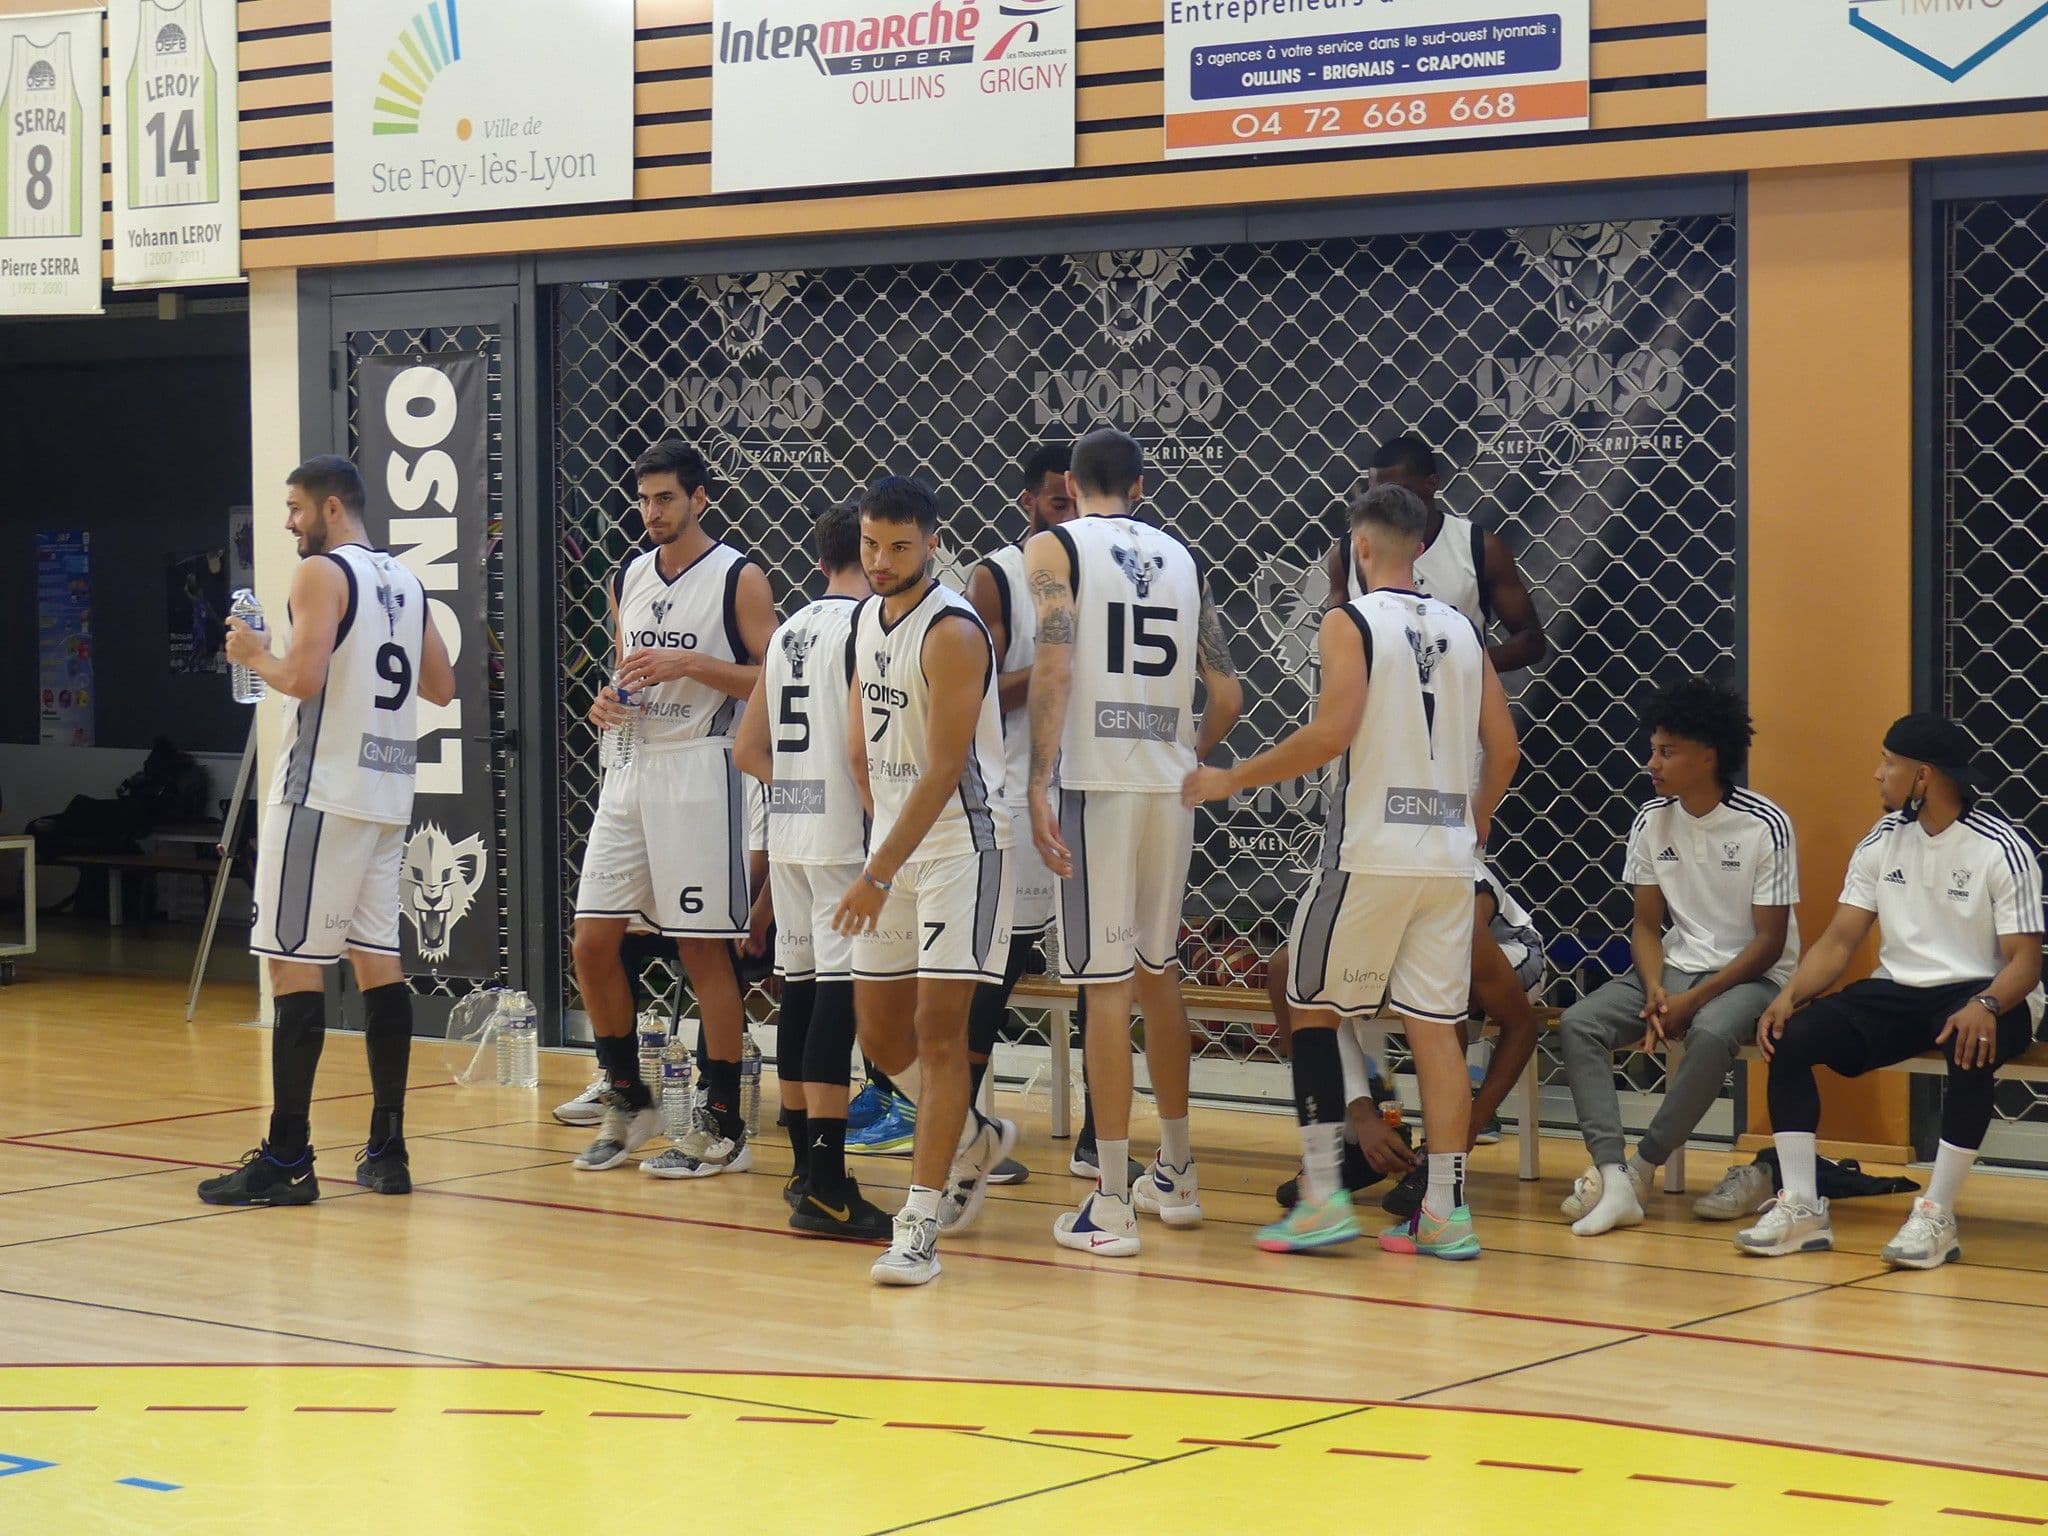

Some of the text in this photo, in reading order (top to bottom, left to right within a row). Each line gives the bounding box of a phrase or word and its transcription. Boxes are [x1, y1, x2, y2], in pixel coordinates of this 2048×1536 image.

[851, 50, 951, 71] SUPER
[1195, 53, 1204, 66] 3
[1208, 49, 1262, 67] agences
[1266, 46, 1276, 60] à
[1280, 44, 1313, 58] votre
[1317, 39, 1363, 55] service
[1368, 37, 1400, 51] dans
[1404, 34, 1418, 48] le
[1422, 27, 1488, 46] sud-ouest
[1493, 22, 1547, 42] lyonnais
[146, 74, 200, 102] LEROY
[853, 63, 1067, 105] OULLINS GRIGNY
[1241, 68, 1302, 87] OULLINS
[1322, 60, 1395, 81] BRIGNAIS
[1416, 50, 1506, 73] CRAPONNE
[15, 108, 66, 136] SERRA
[483, 116, 543, 139] Ville de
[1232, 92, 1516, 138] 04 72 668 668
[146, 109, 200, 177] 14
[26, 144, 53, 210] 8
[372, 151, 597, 198] Ste Foy-lès-Lyon
[128, 224, 222, 247] Yohann LEROY
[1, 257, 80, 276] Pierre SERRA
[663, 376, 824, 429] LYONSO
[1034, 366, 1223, 425] LYONSO
[1475, 350, 1685, 416] LYONSO
[1477, 440, 1532, 455] BSKET
[1108, 602, 1178, 677] 15
[374, 642, 412, 711] 9
[777, 685, 810, 753] 5
[870, 707, 891, 742] 7
[1228, 836, 1287, 852] BASKET
[679, 886, 704, 914] 6
[923, 922, 946, 951] 7
